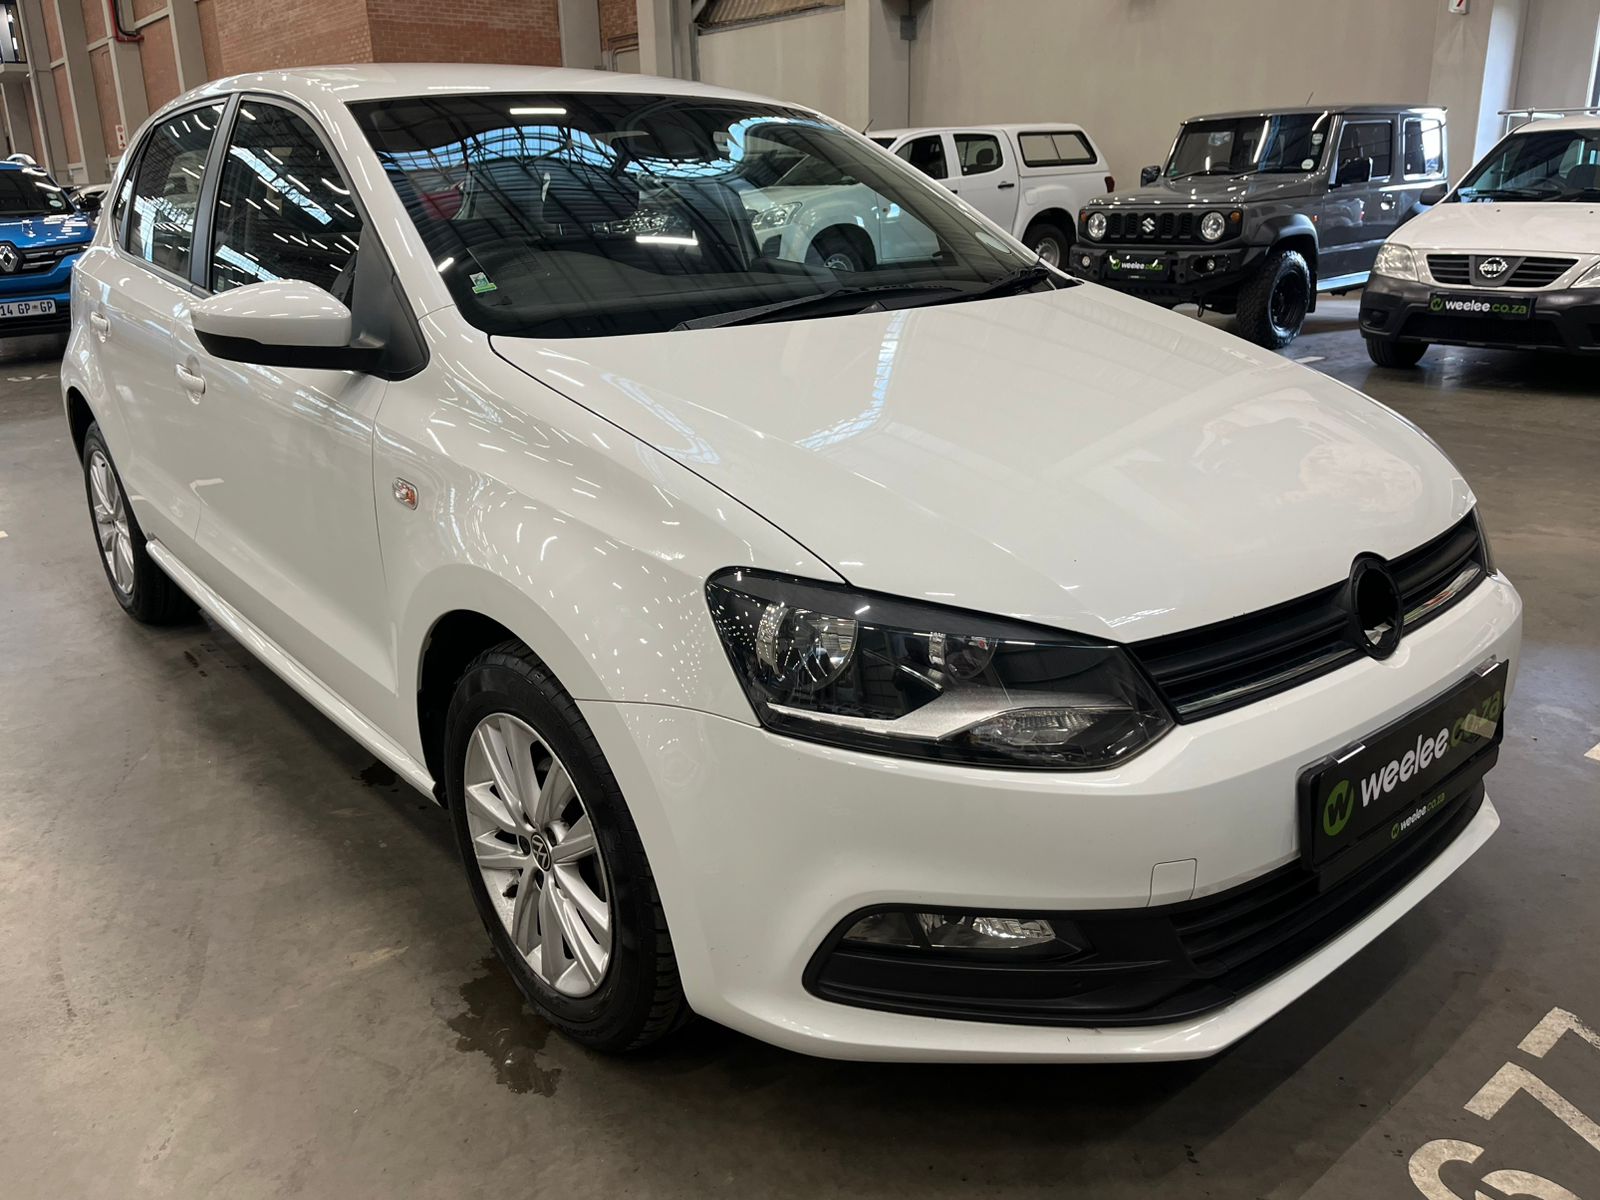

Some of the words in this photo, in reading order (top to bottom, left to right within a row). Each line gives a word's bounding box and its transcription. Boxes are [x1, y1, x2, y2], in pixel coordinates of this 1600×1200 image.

[18, 303, 30, 315] GP
[40, 301, 53, 313] GP
[1445, 299, 1527, 314] weelee.co.za
